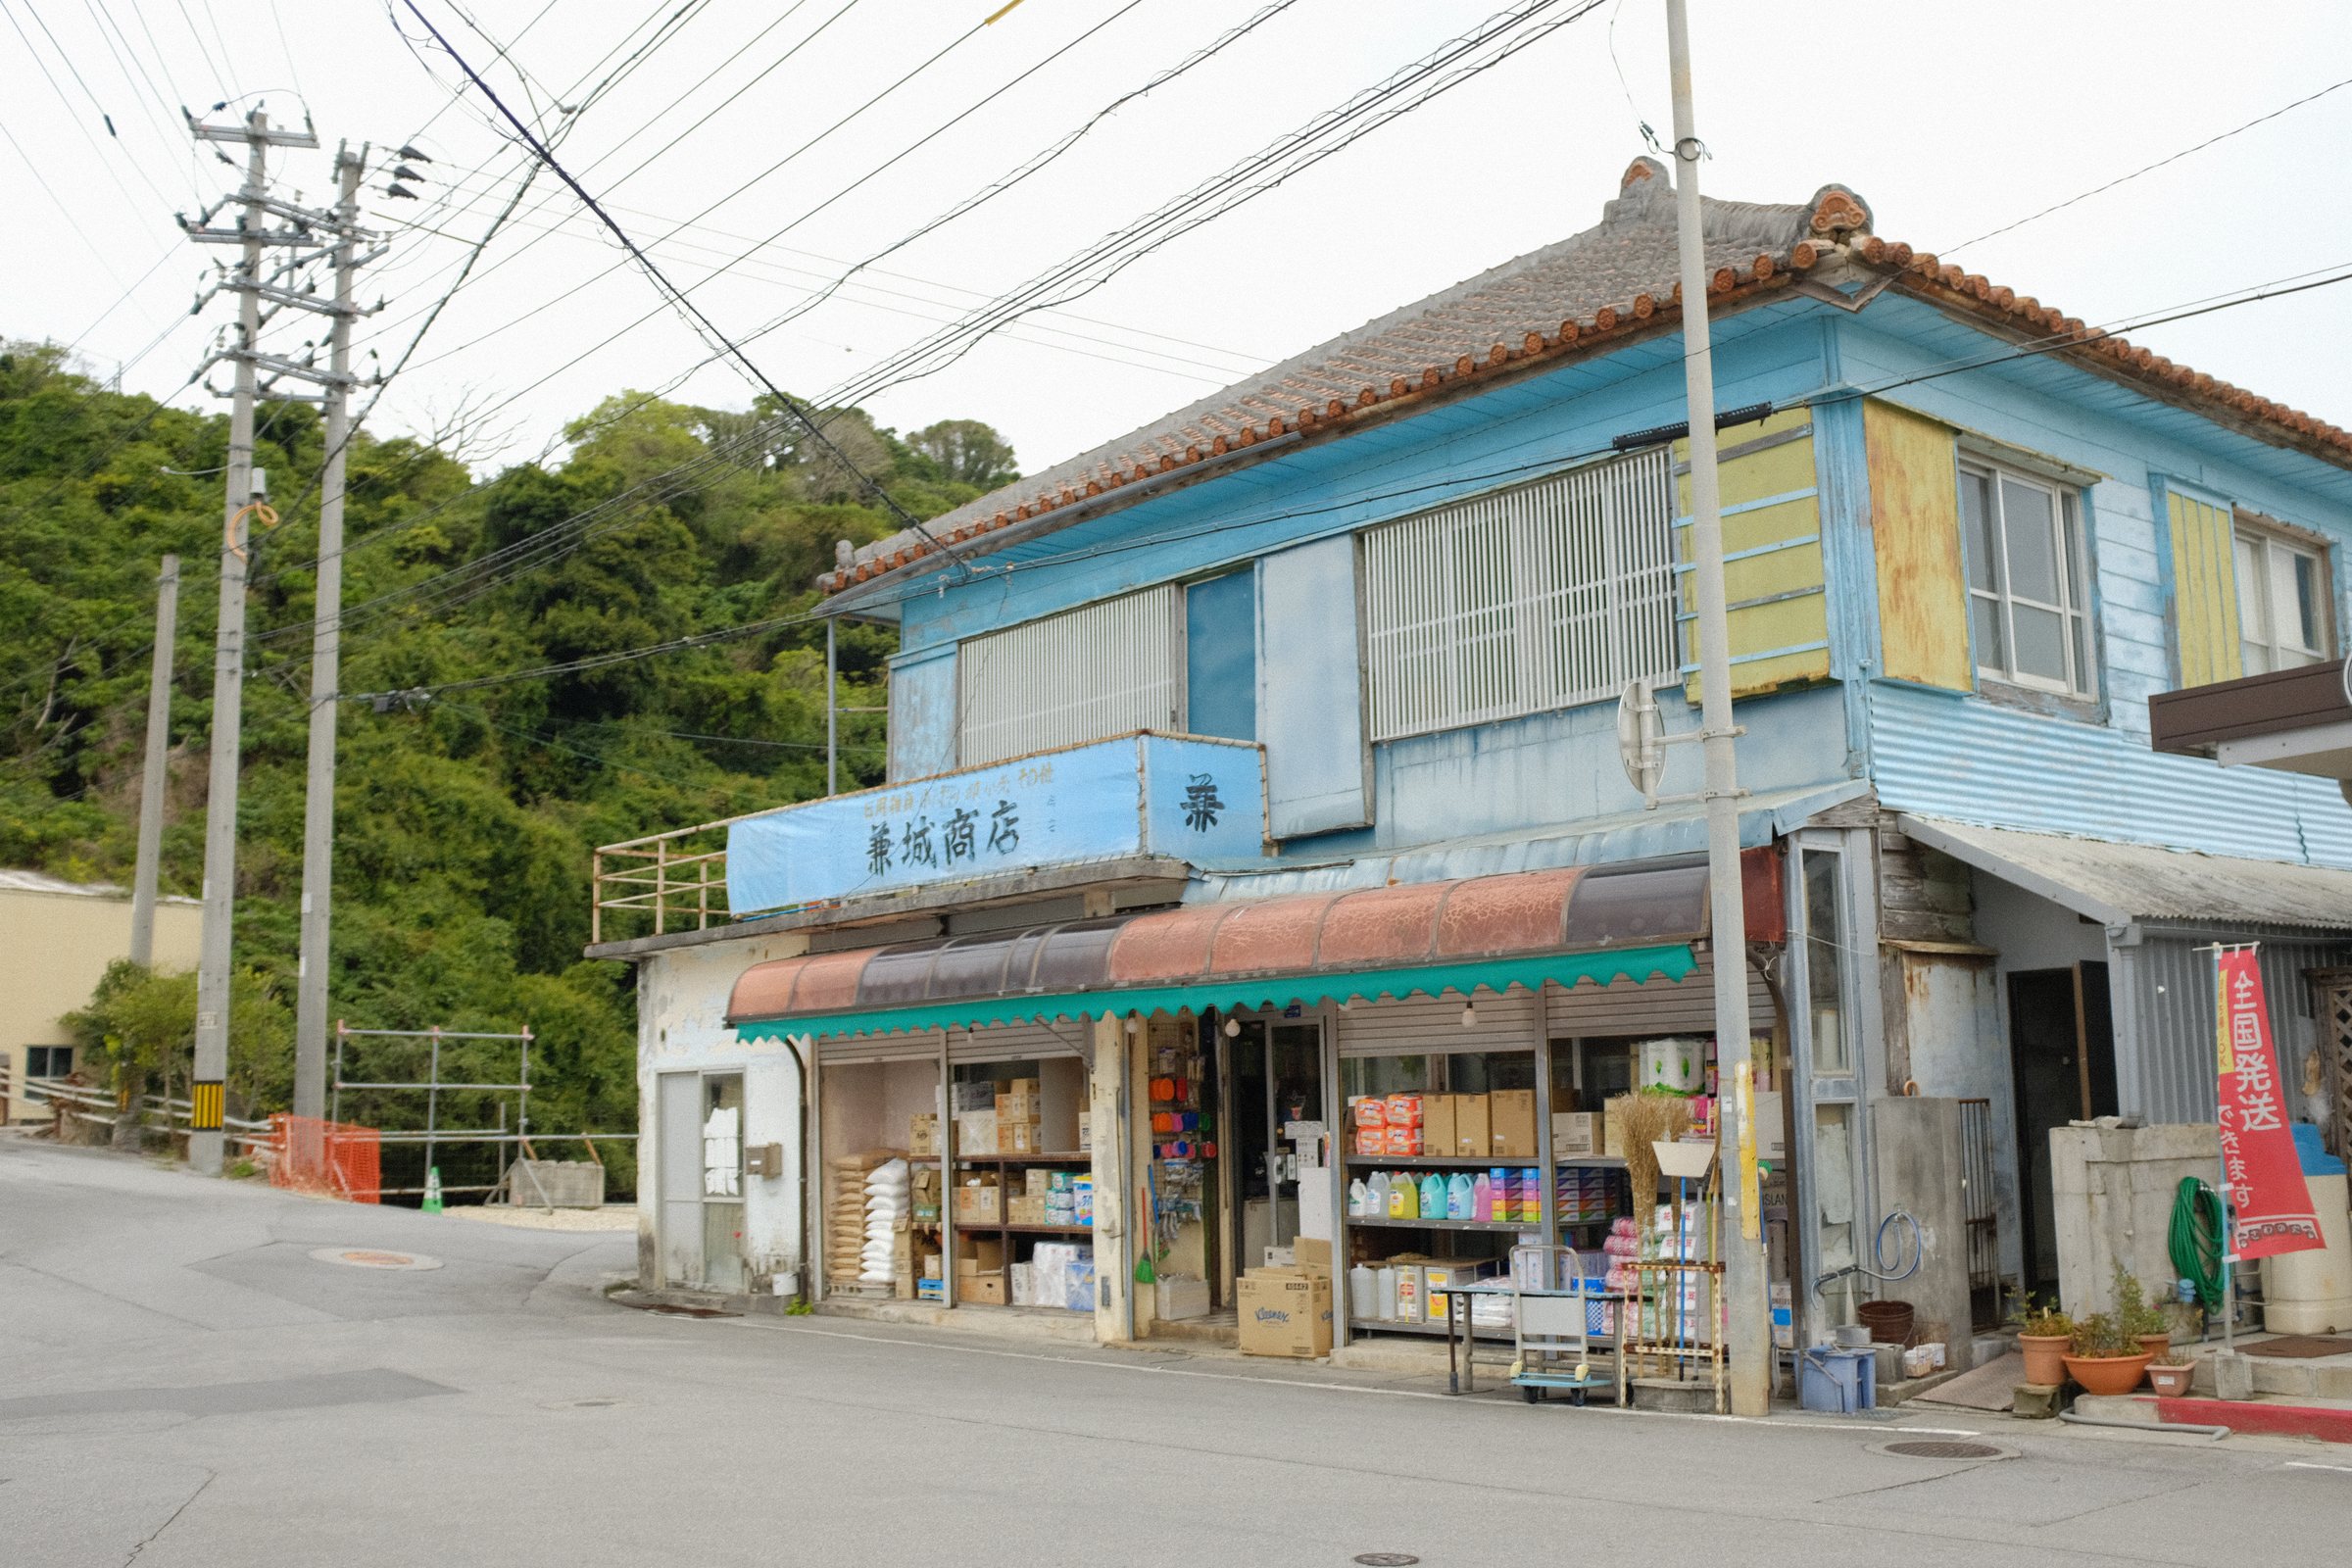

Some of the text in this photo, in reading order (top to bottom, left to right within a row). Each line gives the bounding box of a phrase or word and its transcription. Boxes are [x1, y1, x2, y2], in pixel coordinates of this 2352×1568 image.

[865, 800, 1020, 877] 兼城商店
[2233, 970, 2281, 1131] 全国発送
[2218, 1103, 2254, 1208] できます
